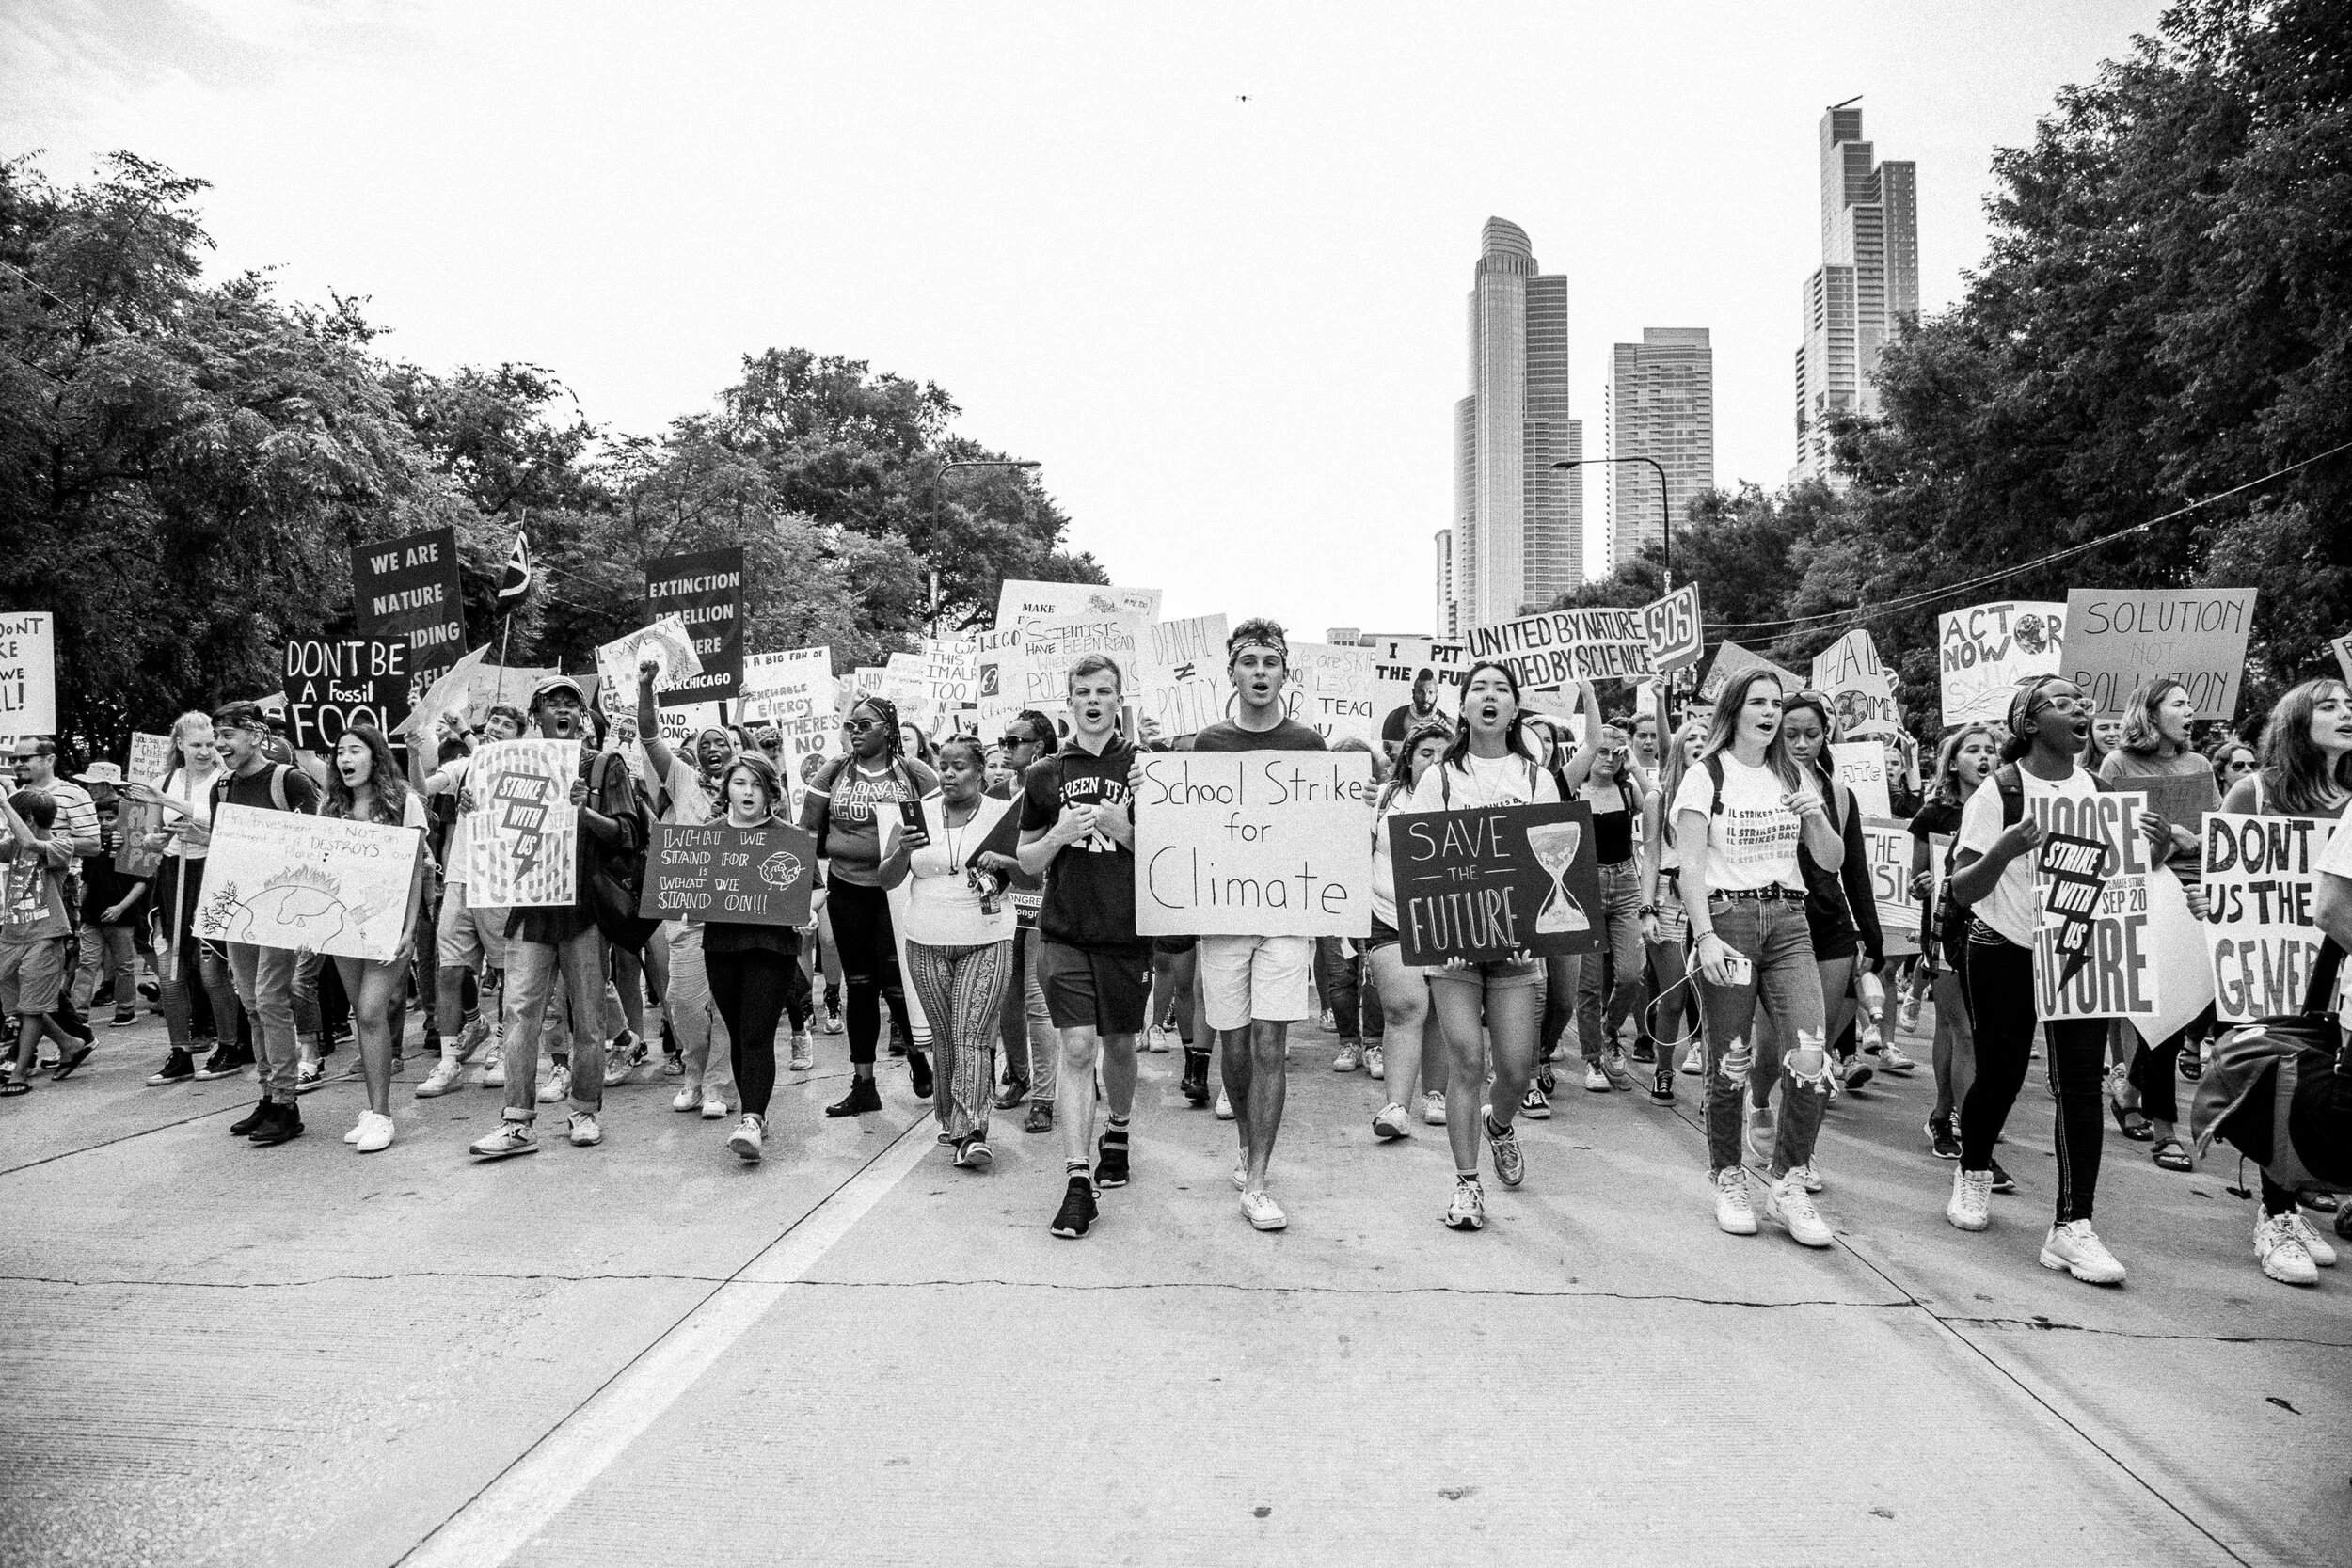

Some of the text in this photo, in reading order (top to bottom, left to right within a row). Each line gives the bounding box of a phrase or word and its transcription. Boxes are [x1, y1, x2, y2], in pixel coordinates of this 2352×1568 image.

[370, 543, 439, 575] WE ARE
[649, 571, 740, 599] EXTINCTION
[373, 583, 444, 616] NATURE
[1022, 602, 1056, 614] MAKE
[1649, 593, 1692, 653] SOS
[1944, 604, 2015, 645] ACT
[2083, 599, 2246, 635] SOLUTION
[1026, 642, 1056, 657] HAVE
[1063, 637, 1102, 655] BEEN
[1151, 616, 1212, 666] DENIAL
[1468, 610, 1647, 658] UNITED BY NATURE
[287, 640, 406, 677] DON'T BE
[765, 654, 785, 666] BIG
[788, 651, 808, 661] FAN
[1389, 643, 1464, 664] I PIT
[1549, 647, 1574, 683] BY
[1575, 643, 1658, 678] SCIENCE
[1943, 635, 2012, 673] NOW
[2130, 641, 2176, 666] NOT
[1375, 664, 1413, 682] THE
[301, 679, 373, 703] A Fossil
[2074, 671, 2228, 713] POLTION
[783, 714, 840, 736] THERE'S
[795, 734, 826, 754] NO
[498, 776, 546, 800] STRIKE
[1145, 759, 1363, 806] School Strike
[509, 805, 544, 828] WITH
[1224, 812, 1272, 843] for
[1740, 809, 1773, 819] STRIKES
[346, 828, 380, 839] NOT
[516, 834, 538, 856] US
[663, 828, 768, 848] WHAT WE
[1408, 815, 1511, 862] SAVE
[1738, 833, 1776, 846] STRIKES
[1739, 825, 1777, 838] STRIKES
[660, 850, 750, 867] STAND FOR
[2043, 840, 2102, 876] STRIKE
[2206, 817, 2315, 875] DON'T
[660, 876, 740, 892] WHAT WE
[1149, 846, 1348, 915] Climate
[1446, 864, 1480, 882] THE
[658, 890, 712, 910] STAND
[2053, 880, 2098, 913] WITH
[2102, 887, 2148, 914] SEP 20
[2205, 880, 2314, 927] US THE
[1408, 886, 1521, 954] FUTURE
[2063, 921, 2089, 951] US
